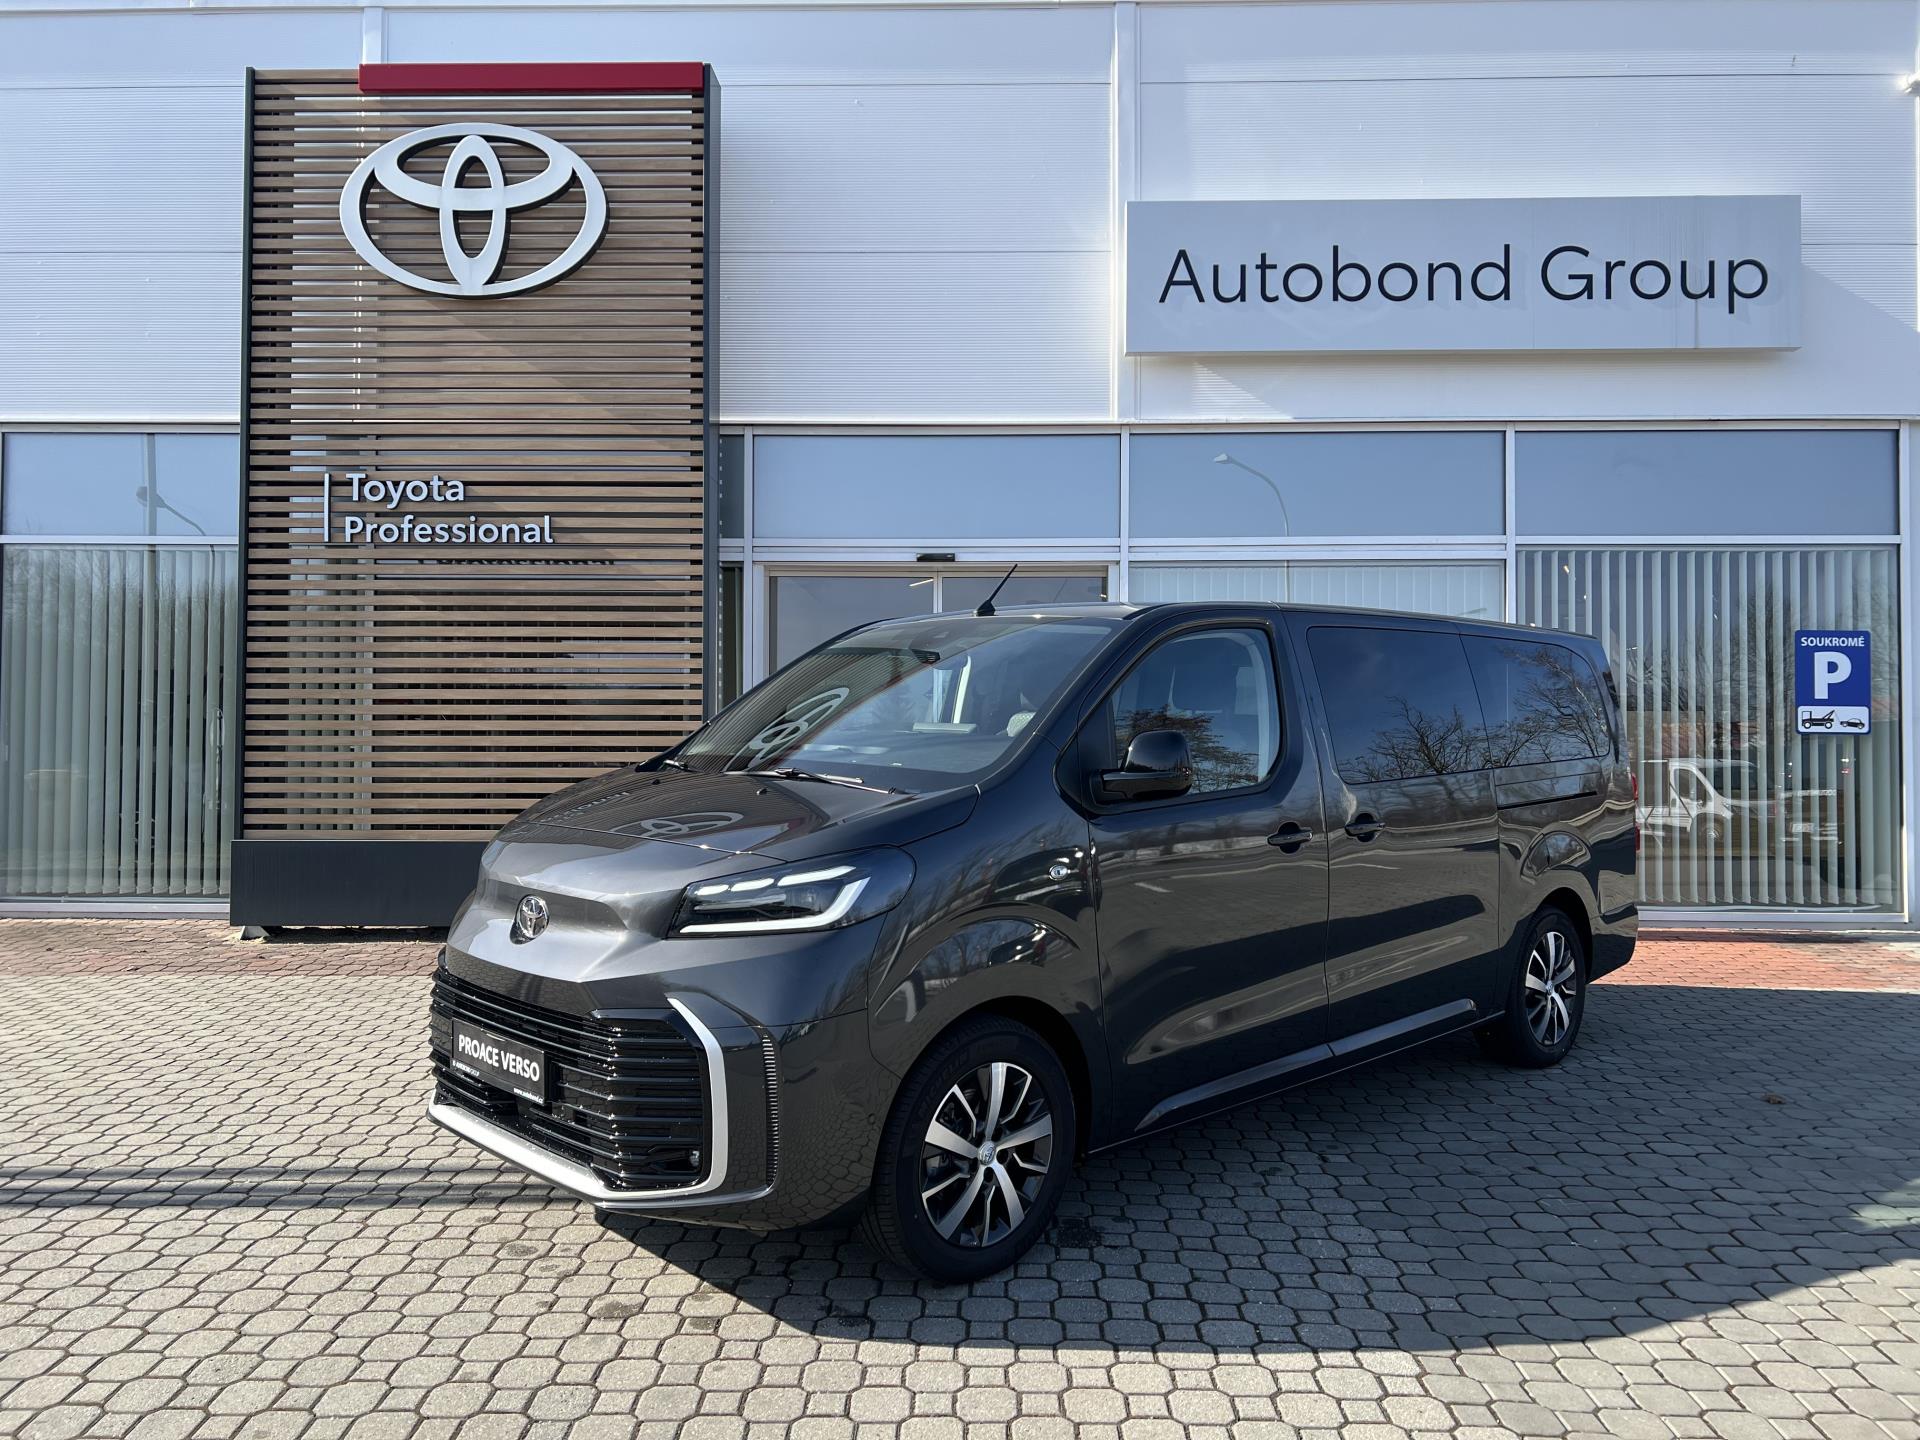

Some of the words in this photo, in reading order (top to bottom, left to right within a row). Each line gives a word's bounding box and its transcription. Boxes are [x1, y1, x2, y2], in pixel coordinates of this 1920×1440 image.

[1158, 243, 1511, 304] Autobond
[1540, 244, 1769, 315] Group
[345, 472, 465, 509] Toyota
[344, 514, 554, 544] Professional
[1801, 635, 1865, 647] SOUKROMÉ
[1814, 651, 1852, 700] P
[458, 1034, 500, 1068] PROACE
[500, 1050, 541, 1082] VERSO
